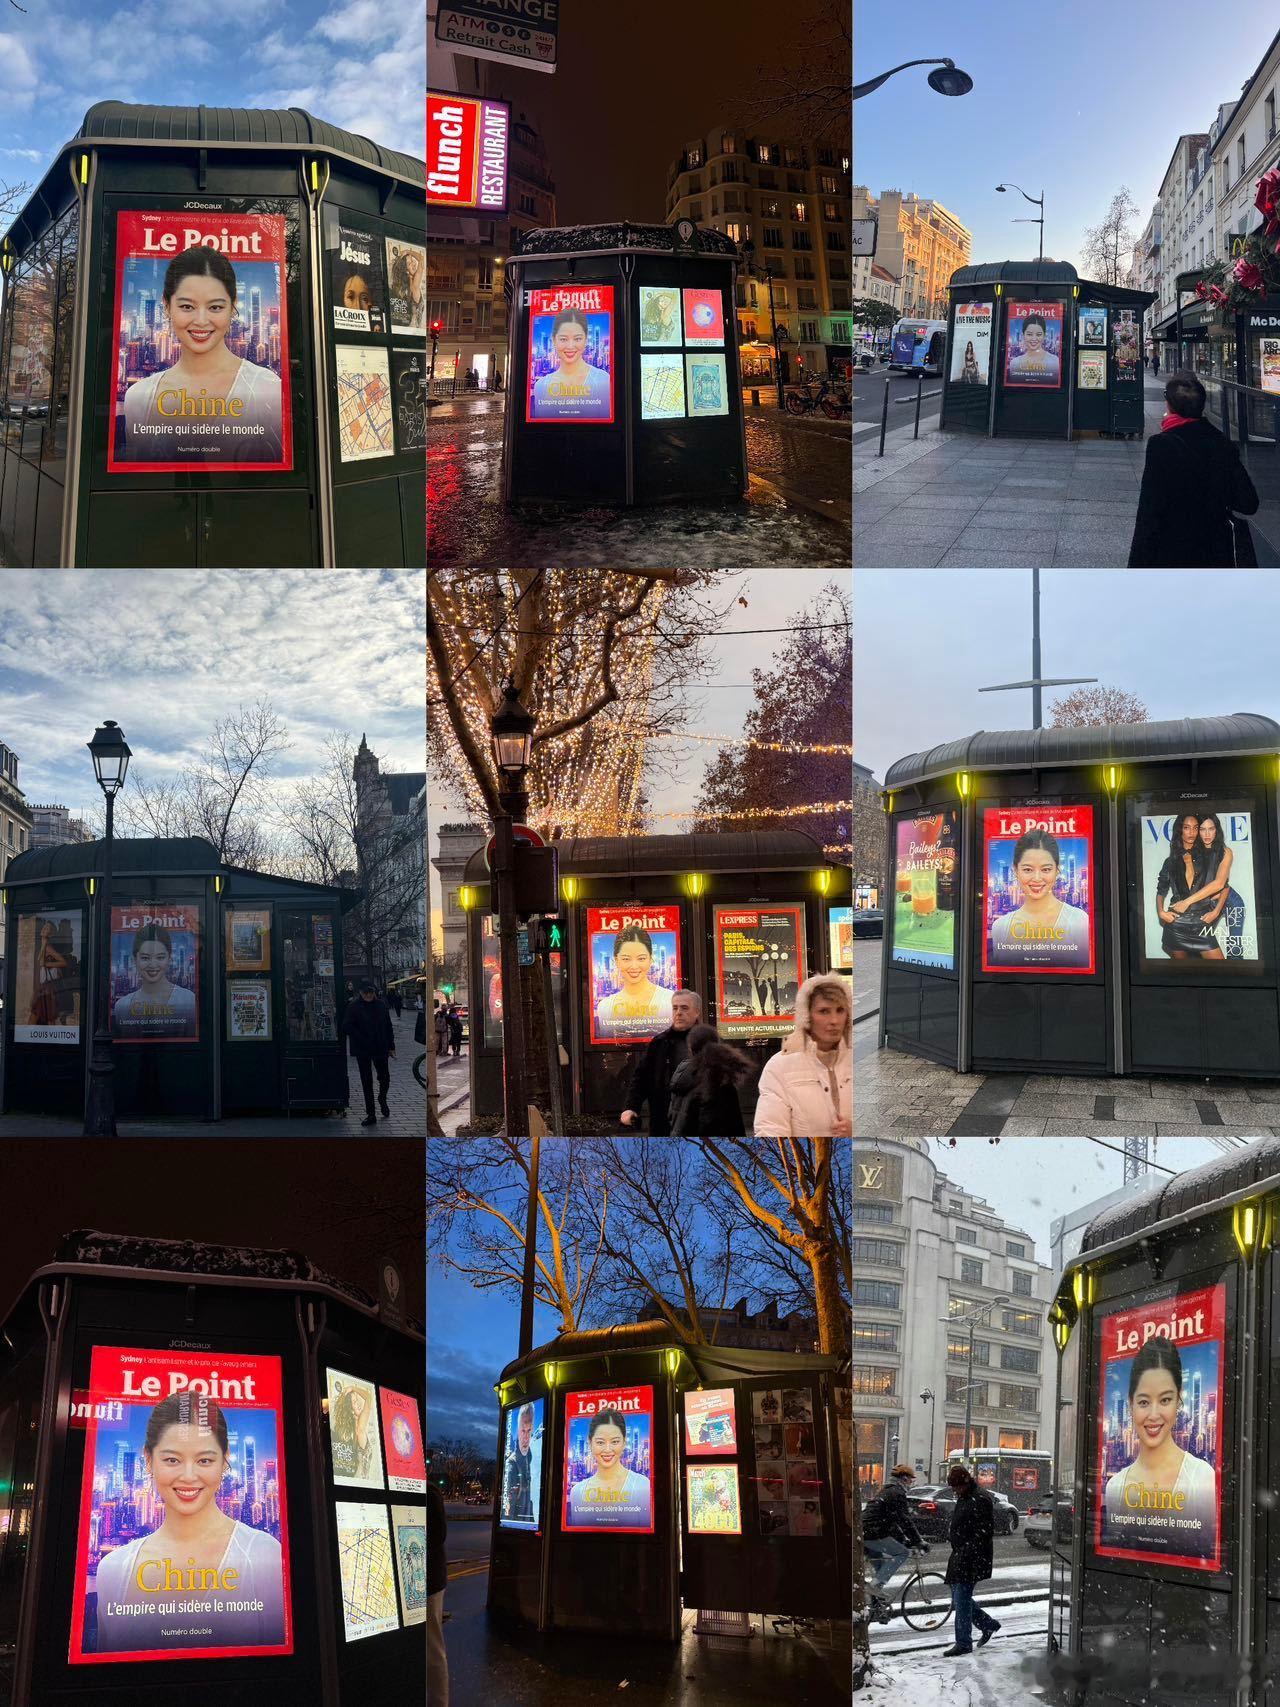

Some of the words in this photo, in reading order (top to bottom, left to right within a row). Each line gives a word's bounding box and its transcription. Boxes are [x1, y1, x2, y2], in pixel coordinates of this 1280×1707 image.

[447, 14, 485, 31] ATM
[446, 28, 495, 47] Retrait
[499, 39, 531, 55] Cash
[427, 105, 463, 195] flunch
[481, 105, 507, 206] RESTAURANT
[184, 201, 222, 210] JCDecaux
[143, 228, 178, 251] Le
[183, 228, 262, 253] Point
[340, 241, 371, 266] Jésus
[542, 300, 559, 312] Le
[1016, 308, 1028, 317] Le
[1029, 307, 1056, 317] Point
[343, 309, 366, 321] CROIX
[1263, 341, 1279, 349] BIG
[157, 389, 244, 417] Chine
[133, 423, 173, 435] L'empire
[175, 424, 190, 435] qui
[192, 424, 220, 434] sidère
[222, 424, 230, 434] le
[232, 424, 265, 435] monde
[999, 819, 1022, 835] Le
[1024, 816, 1076, 834] Point
[908, 840, 942, 858] Baileys?
[906, 859, 943, 871] BAILEYS!
[121, 915, 140, 928] Le
[143, 913, 186, 928] Point
[600, 917, 620, 930] Le
[621, 915, 666, 930] Point
[1010, 921, 1065, 940] Chine
[30, 1031, 48, 1039] LOUIS
[49, 1031, 76, 1039] VUITTON
[858, 1164, 883, 1189] LV
[1116, 1329, 1139, 1352] Le
[1142, 1308, 1205, 1346] Point
[169, 1339, 211, 1349] JCDecaux
[120, 1354, 143, 1364] Sydney
[121, 1370, 161, 1397] Le
[167, 1371, 256, 1400] Point
[578, 1401, 596, 1414] Le
[597, 1396, 640, 1413] Point
[1124, 1482, 1185, 1512] Chine
[1110, 1513, 1135, 1525] L'empire
[1136, 1515, 1147, 1527] qui
[1148, 1516, 1168, 1527] sidère
[1169, 1517, 1176, 1527] le
[1176, 1518, 1202, 1529] monde
[136, 1557, 239, 1592] Chine
[107, 1601, 155, 1616] L'empire
[159, 1600, 176, 1616] qui
[178, 1600, 211, 1613] sidère
[214, 1599, 224, 1612] le
[226, 1599, 264, 1611] monde
[161, 1628, 188, 1637] Numéro
[189, 1627, 212, 1635] double
